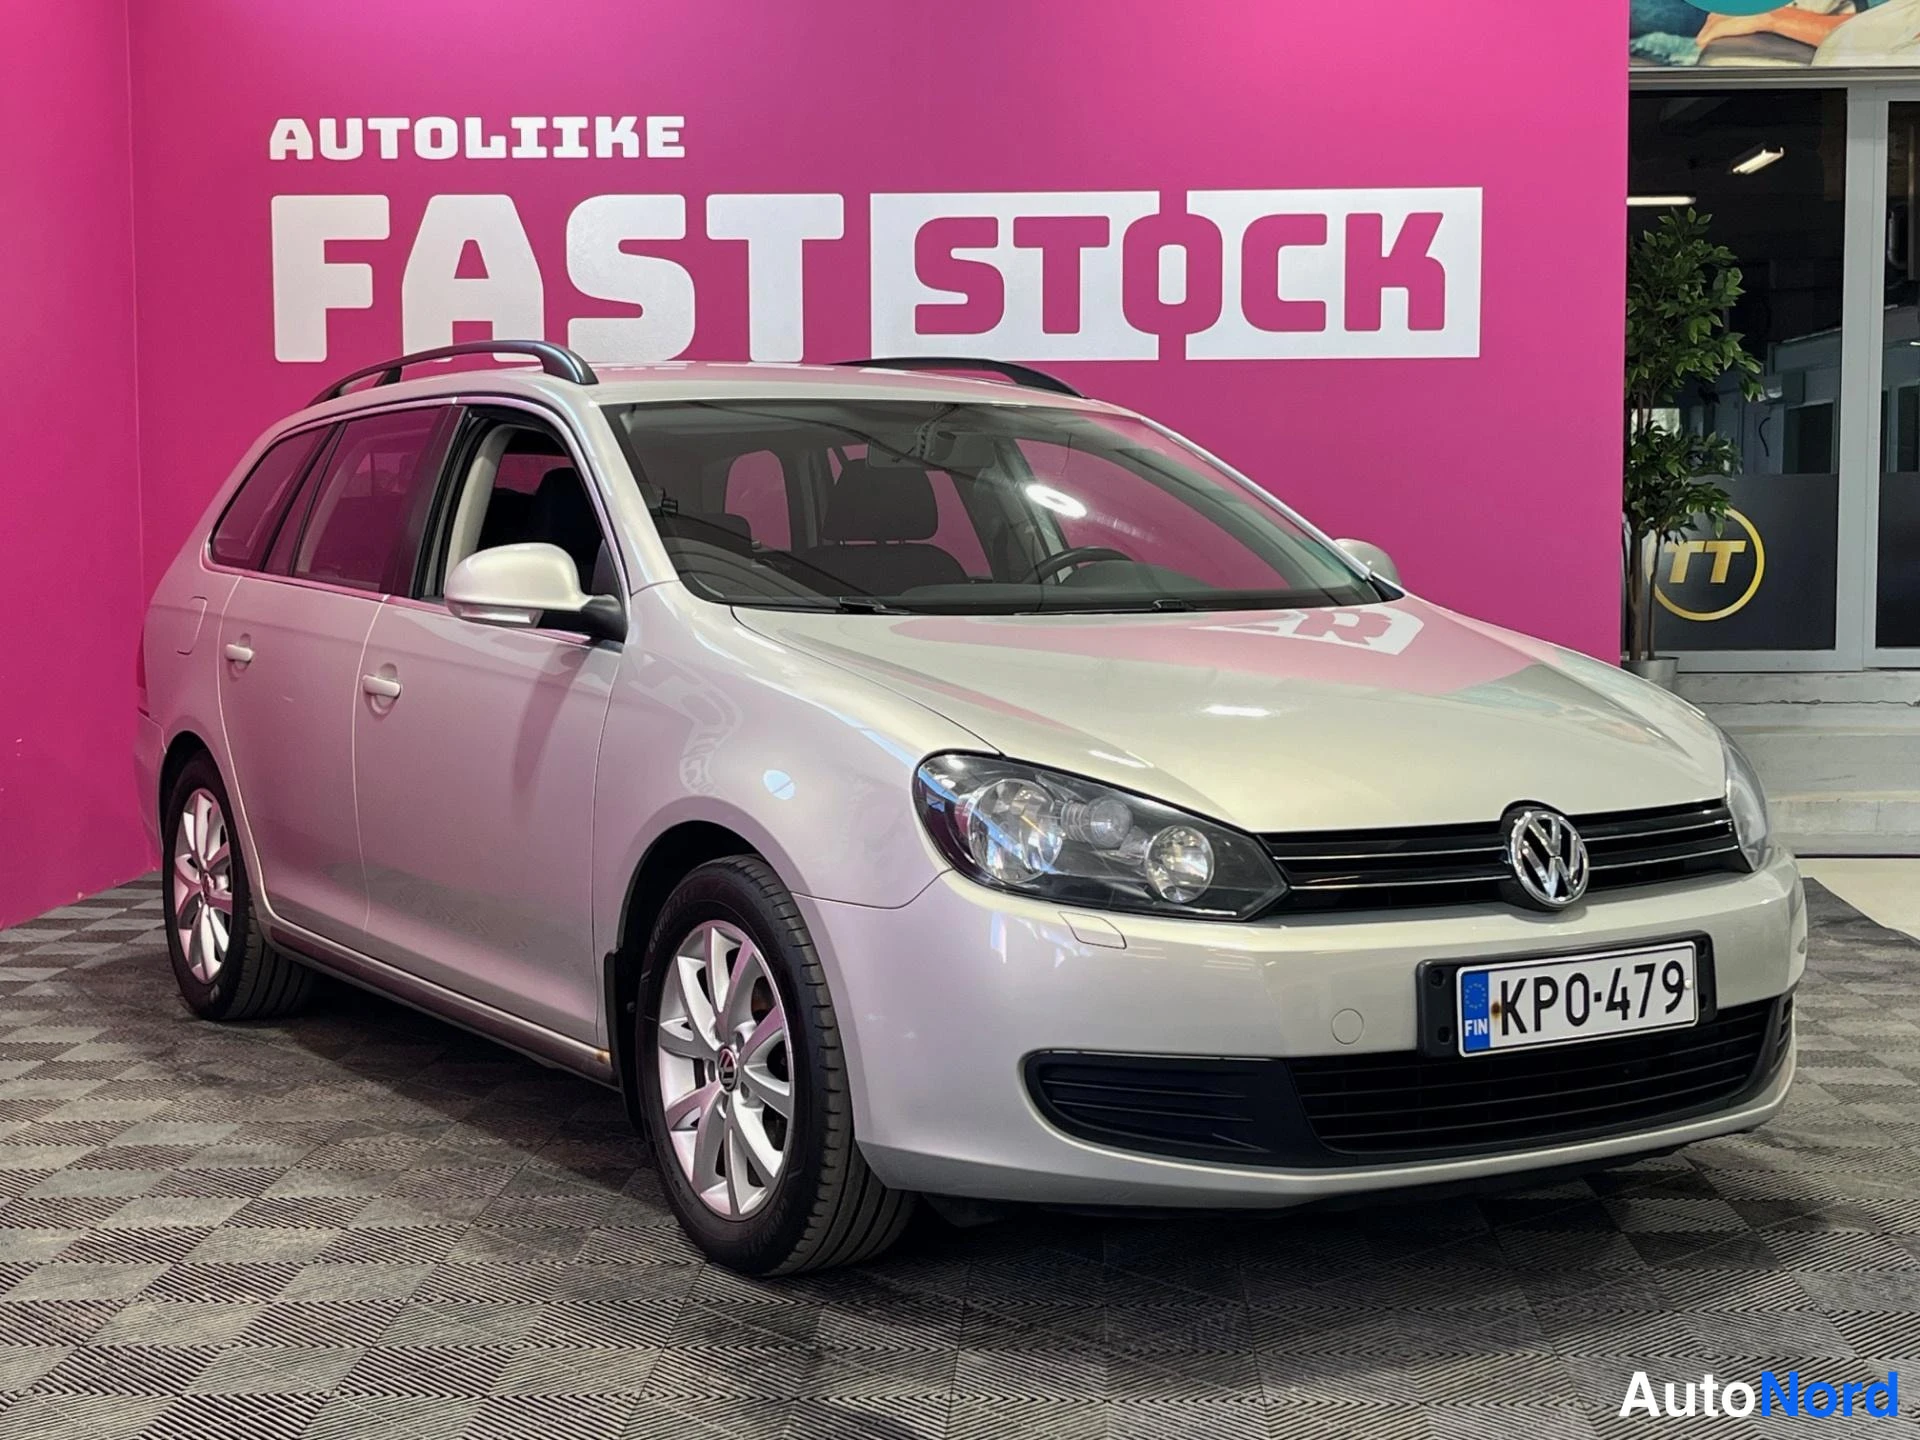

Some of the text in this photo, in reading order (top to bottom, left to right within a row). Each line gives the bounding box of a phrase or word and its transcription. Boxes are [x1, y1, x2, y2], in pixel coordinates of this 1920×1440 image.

[269, 115, 686, 161] AUTOLIIKE
[271, 194, 1446, 363] FAST STOCK
[1463, 959, 1685, 1037] FIN KPO-479
